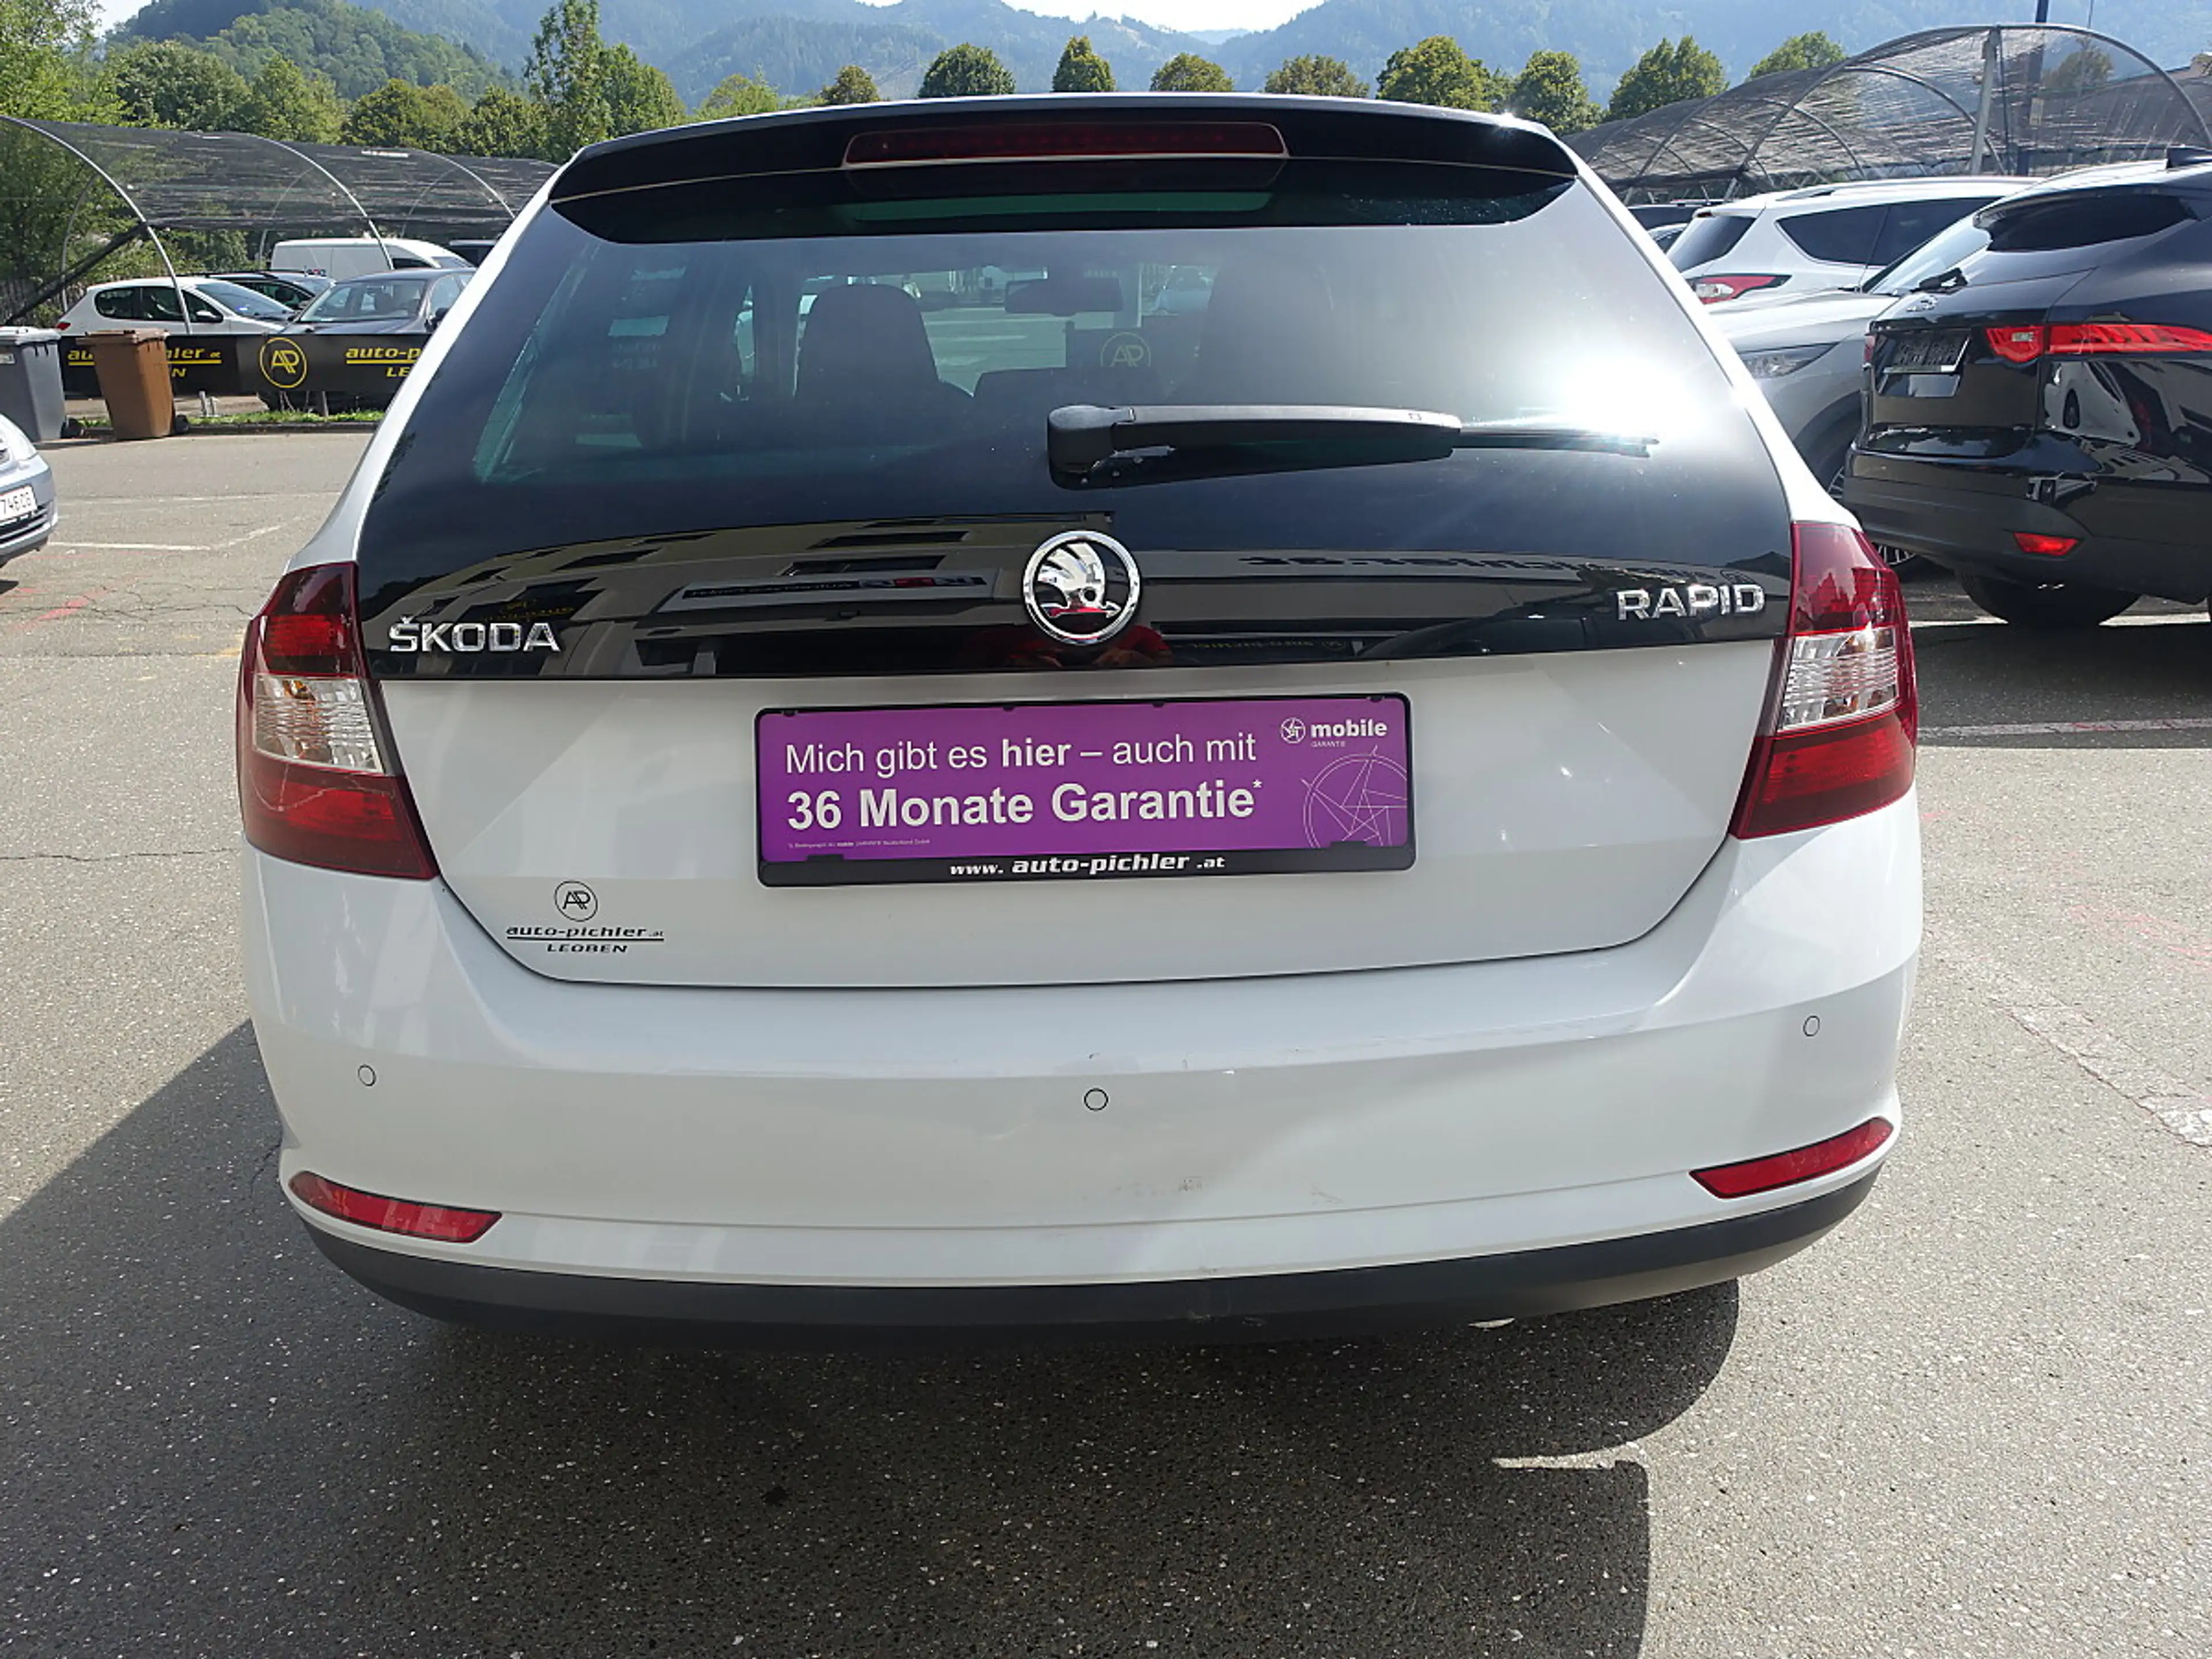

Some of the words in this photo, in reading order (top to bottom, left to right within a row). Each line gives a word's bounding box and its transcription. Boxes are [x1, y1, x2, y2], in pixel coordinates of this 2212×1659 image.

[346, 347, 423, 360] auto-p
[1616, 584, 1765, 620] RAPID
[389, 616, 561, 652] ŠKODA
[1310, 718, 1387, 738] mobile
[786, 743, 864, 774] Mich
[876, 740, 937, 778] gibt
[948, 745, 987, 769] es
[1002, 738, 1071, 768] hier
[1112, 733, 1193, 764] auch
[1206, 732, 1257, 762] mit
[788, 790, 842, 830] 36
[859, 786, 1034, 827] Monate
[949, 864, 1004, 876] www.
[1012, 853, 1190, 876] auto-pichler
[547, 944, 628, 953] LEOBEN
